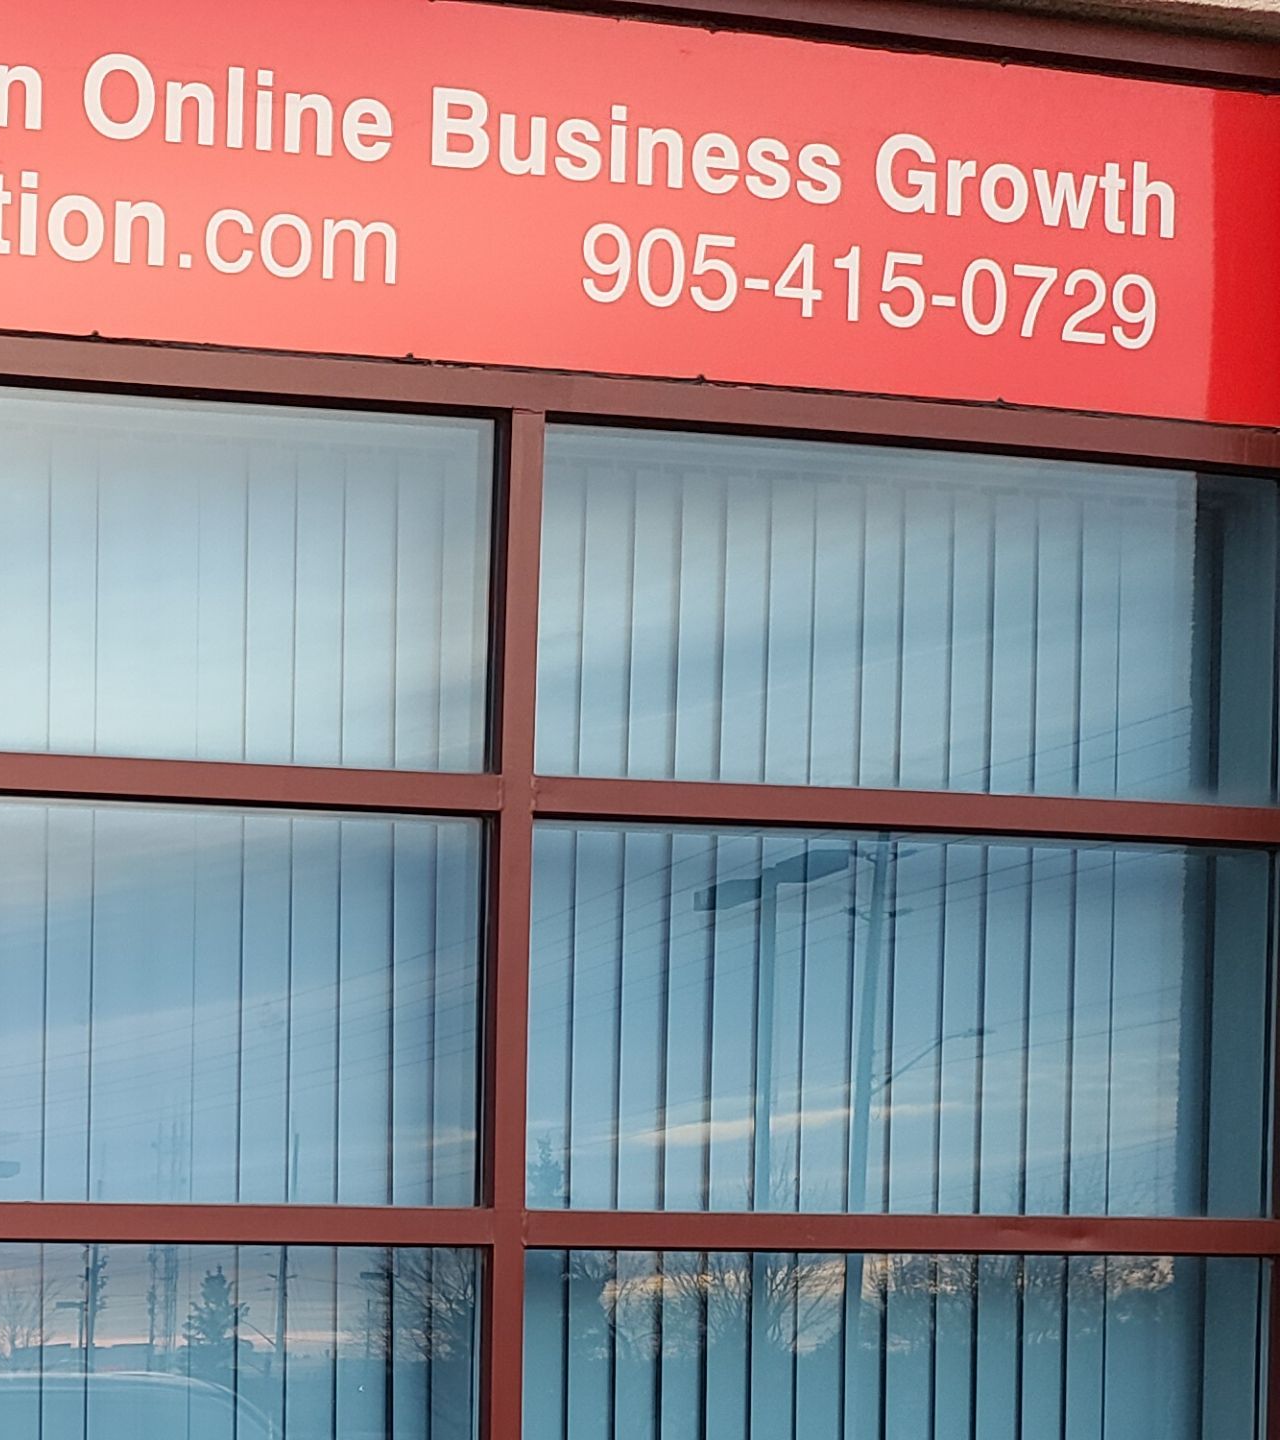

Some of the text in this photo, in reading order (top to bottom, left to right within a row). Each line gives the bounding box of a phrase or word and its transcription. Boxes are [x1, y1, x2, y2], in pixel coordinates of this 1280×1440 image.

[81, 52, 394, 162] Online
[429, 86, 842, 204] Business
[874, 132, 1178, 240] Growth
[580, 222, 1158, 351] 905-415-0729
